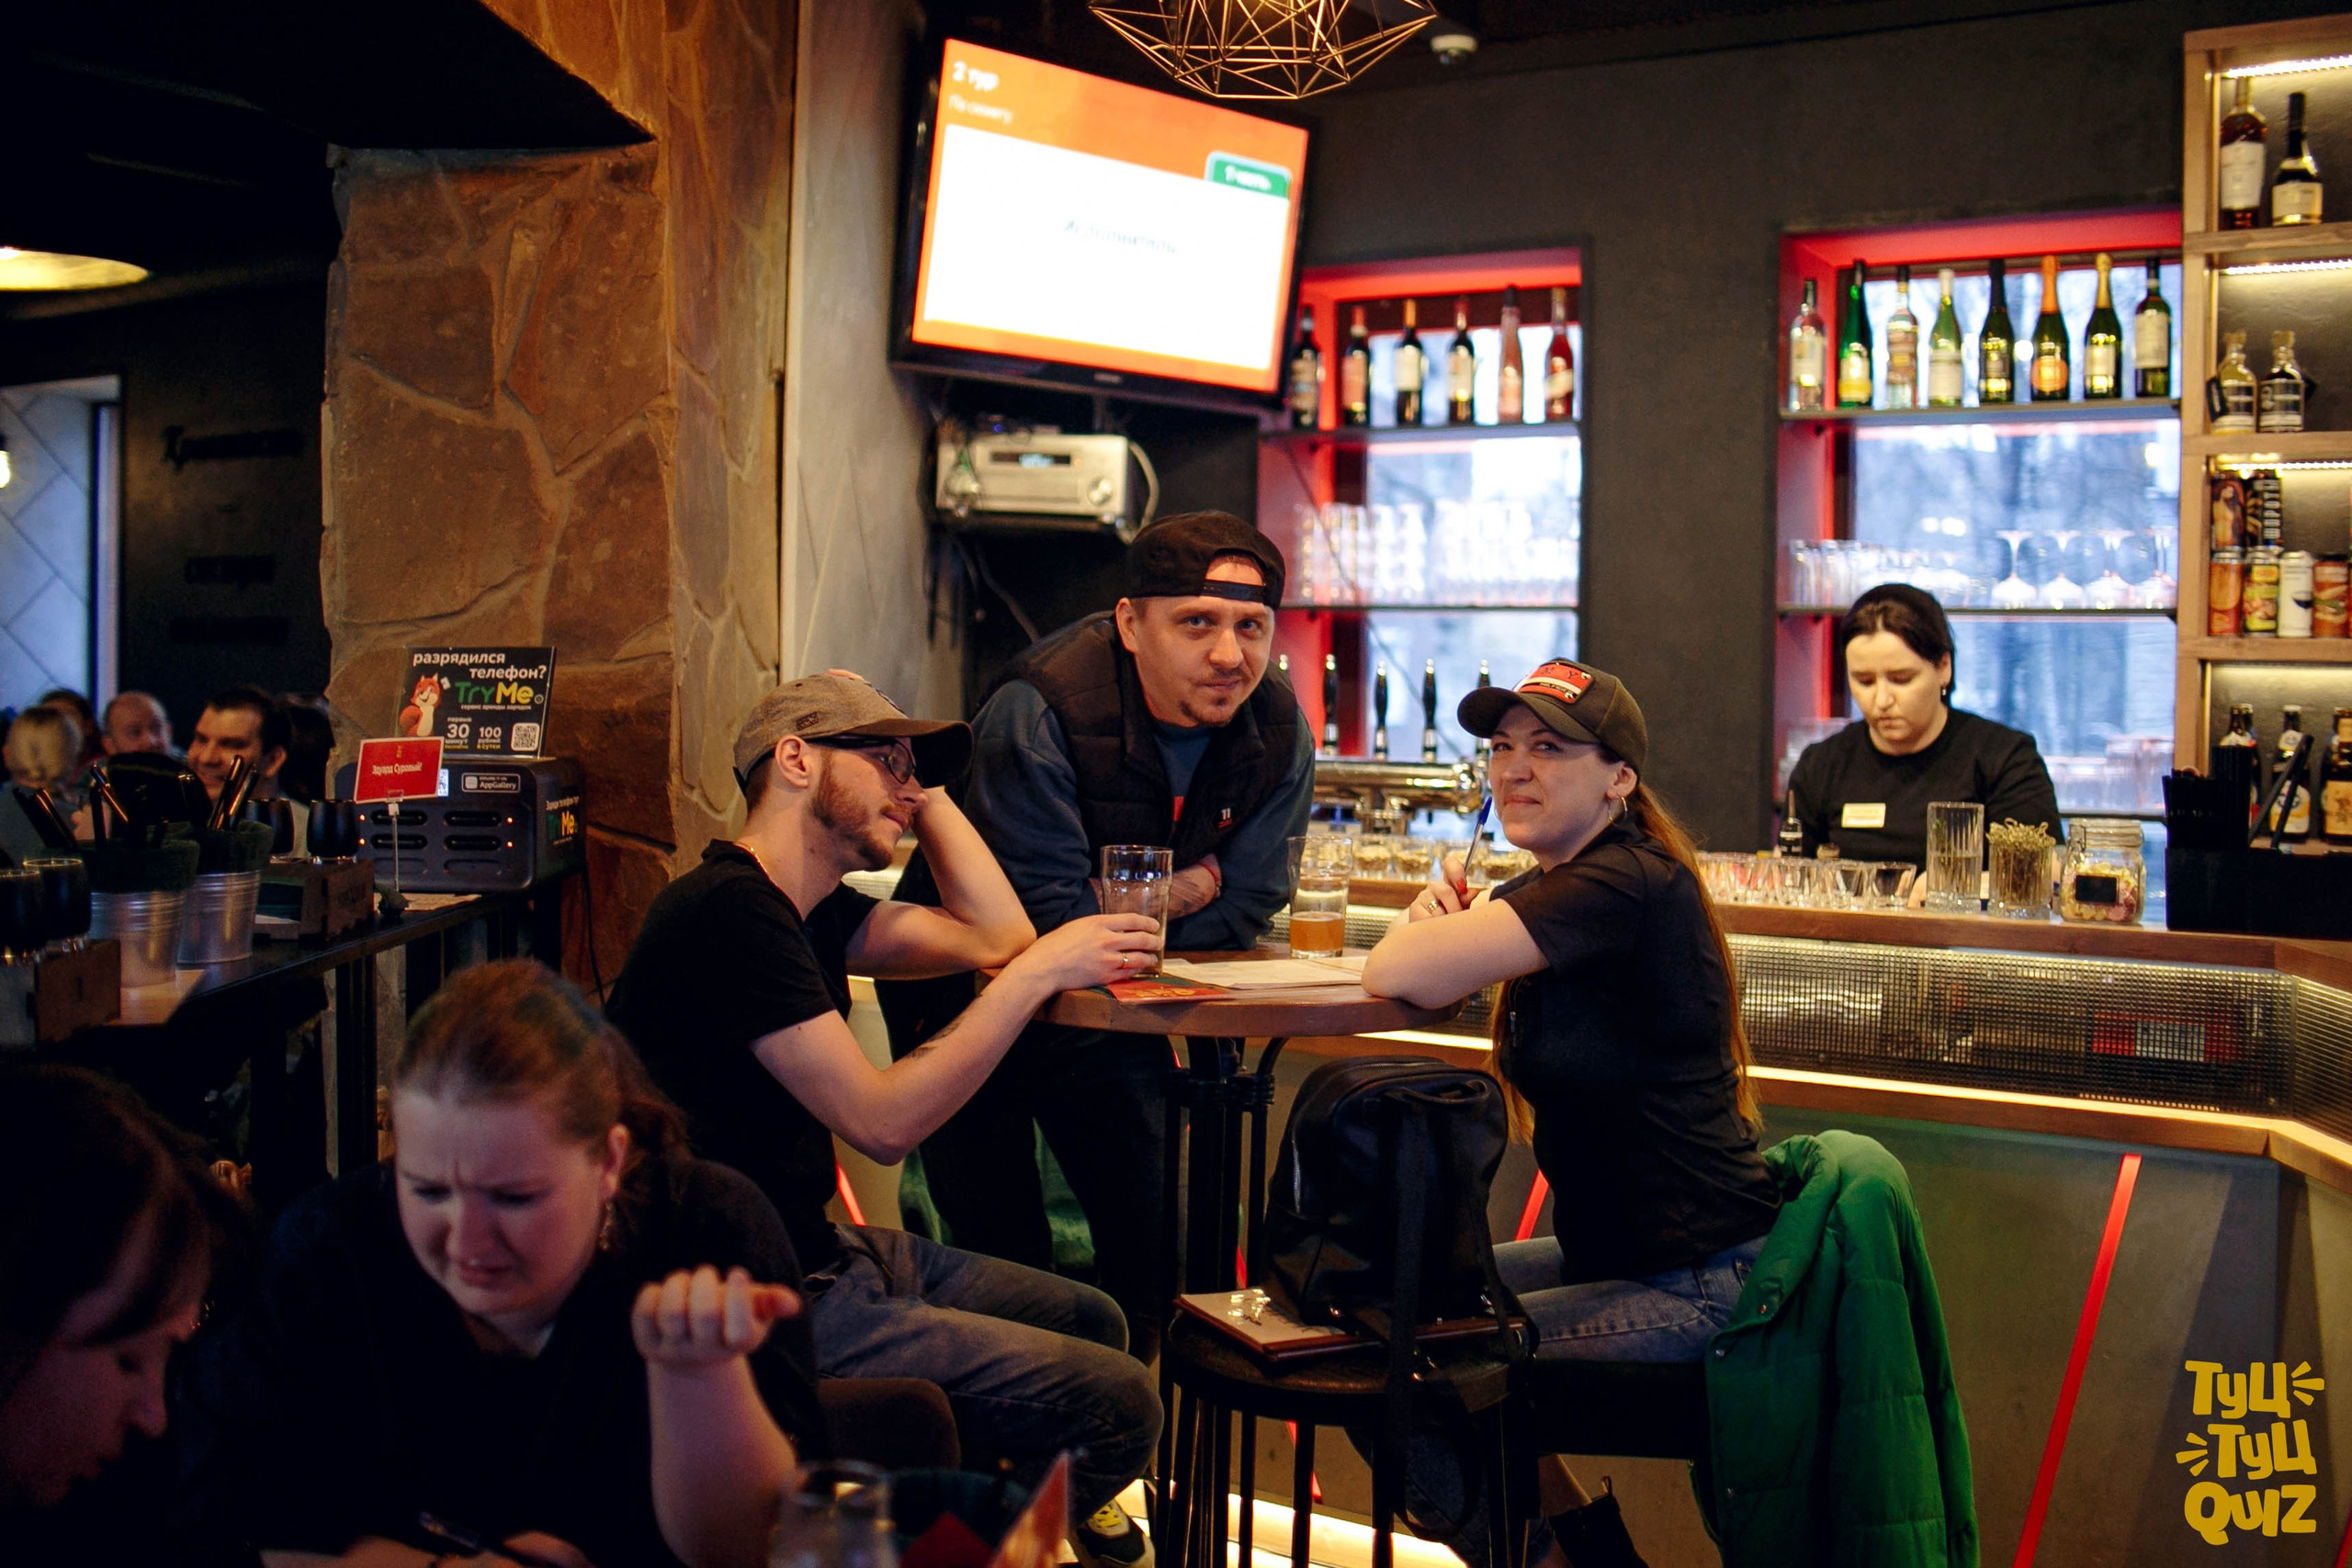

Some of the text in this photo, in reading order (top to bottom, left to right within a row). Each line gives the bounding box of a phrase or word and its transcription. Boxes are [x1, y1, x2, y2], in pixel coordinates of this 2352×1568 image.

[952, 61, 967, 82] 2
[413, 652, 505, 667] разрядился
[469, 664, 548, 682] телефон?
[447, 723, 470, 739] 30
[479, 727, 502, 739] 100
[479, 782, 516, 790] AppGallery
